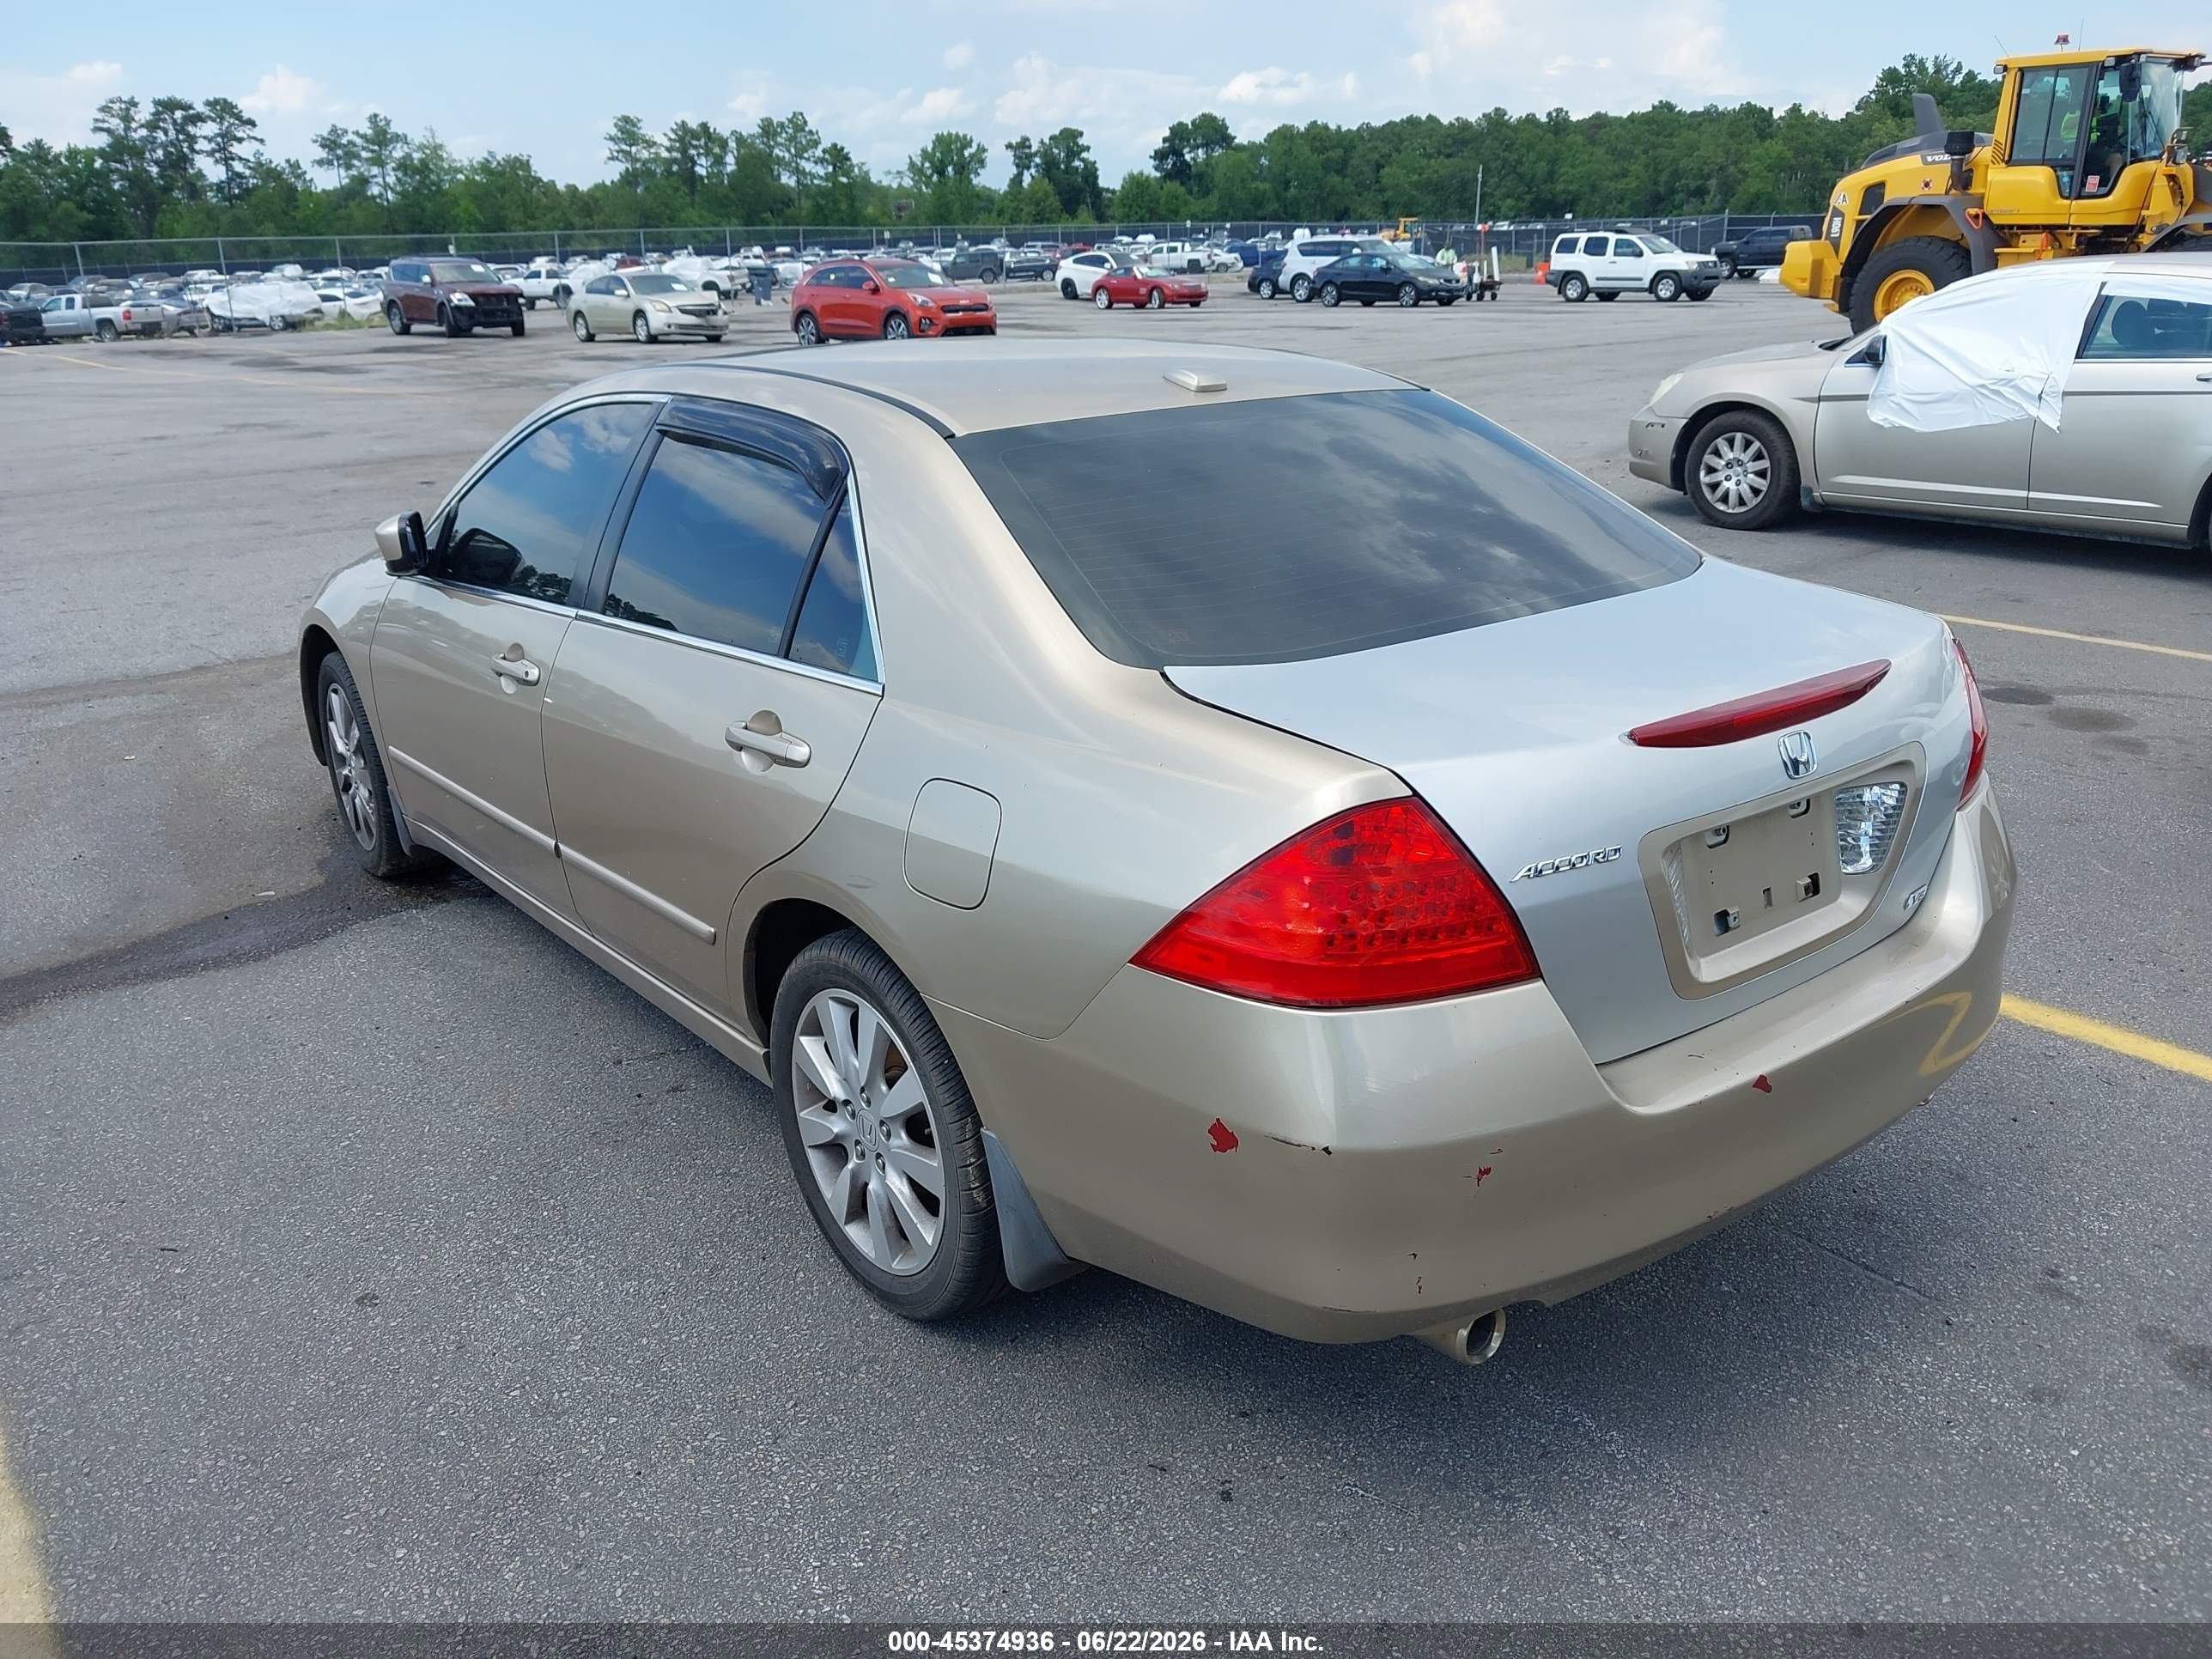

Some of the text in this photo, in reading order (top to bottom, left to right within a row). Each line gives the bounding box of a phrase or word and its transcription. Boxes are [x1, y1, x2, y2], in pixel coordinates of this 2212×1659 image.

[1926, 154, 1951, 162] VOL
[1830, 216, 1843, 238] L90H
[1510, 845, 1622, 883] ACCORD
